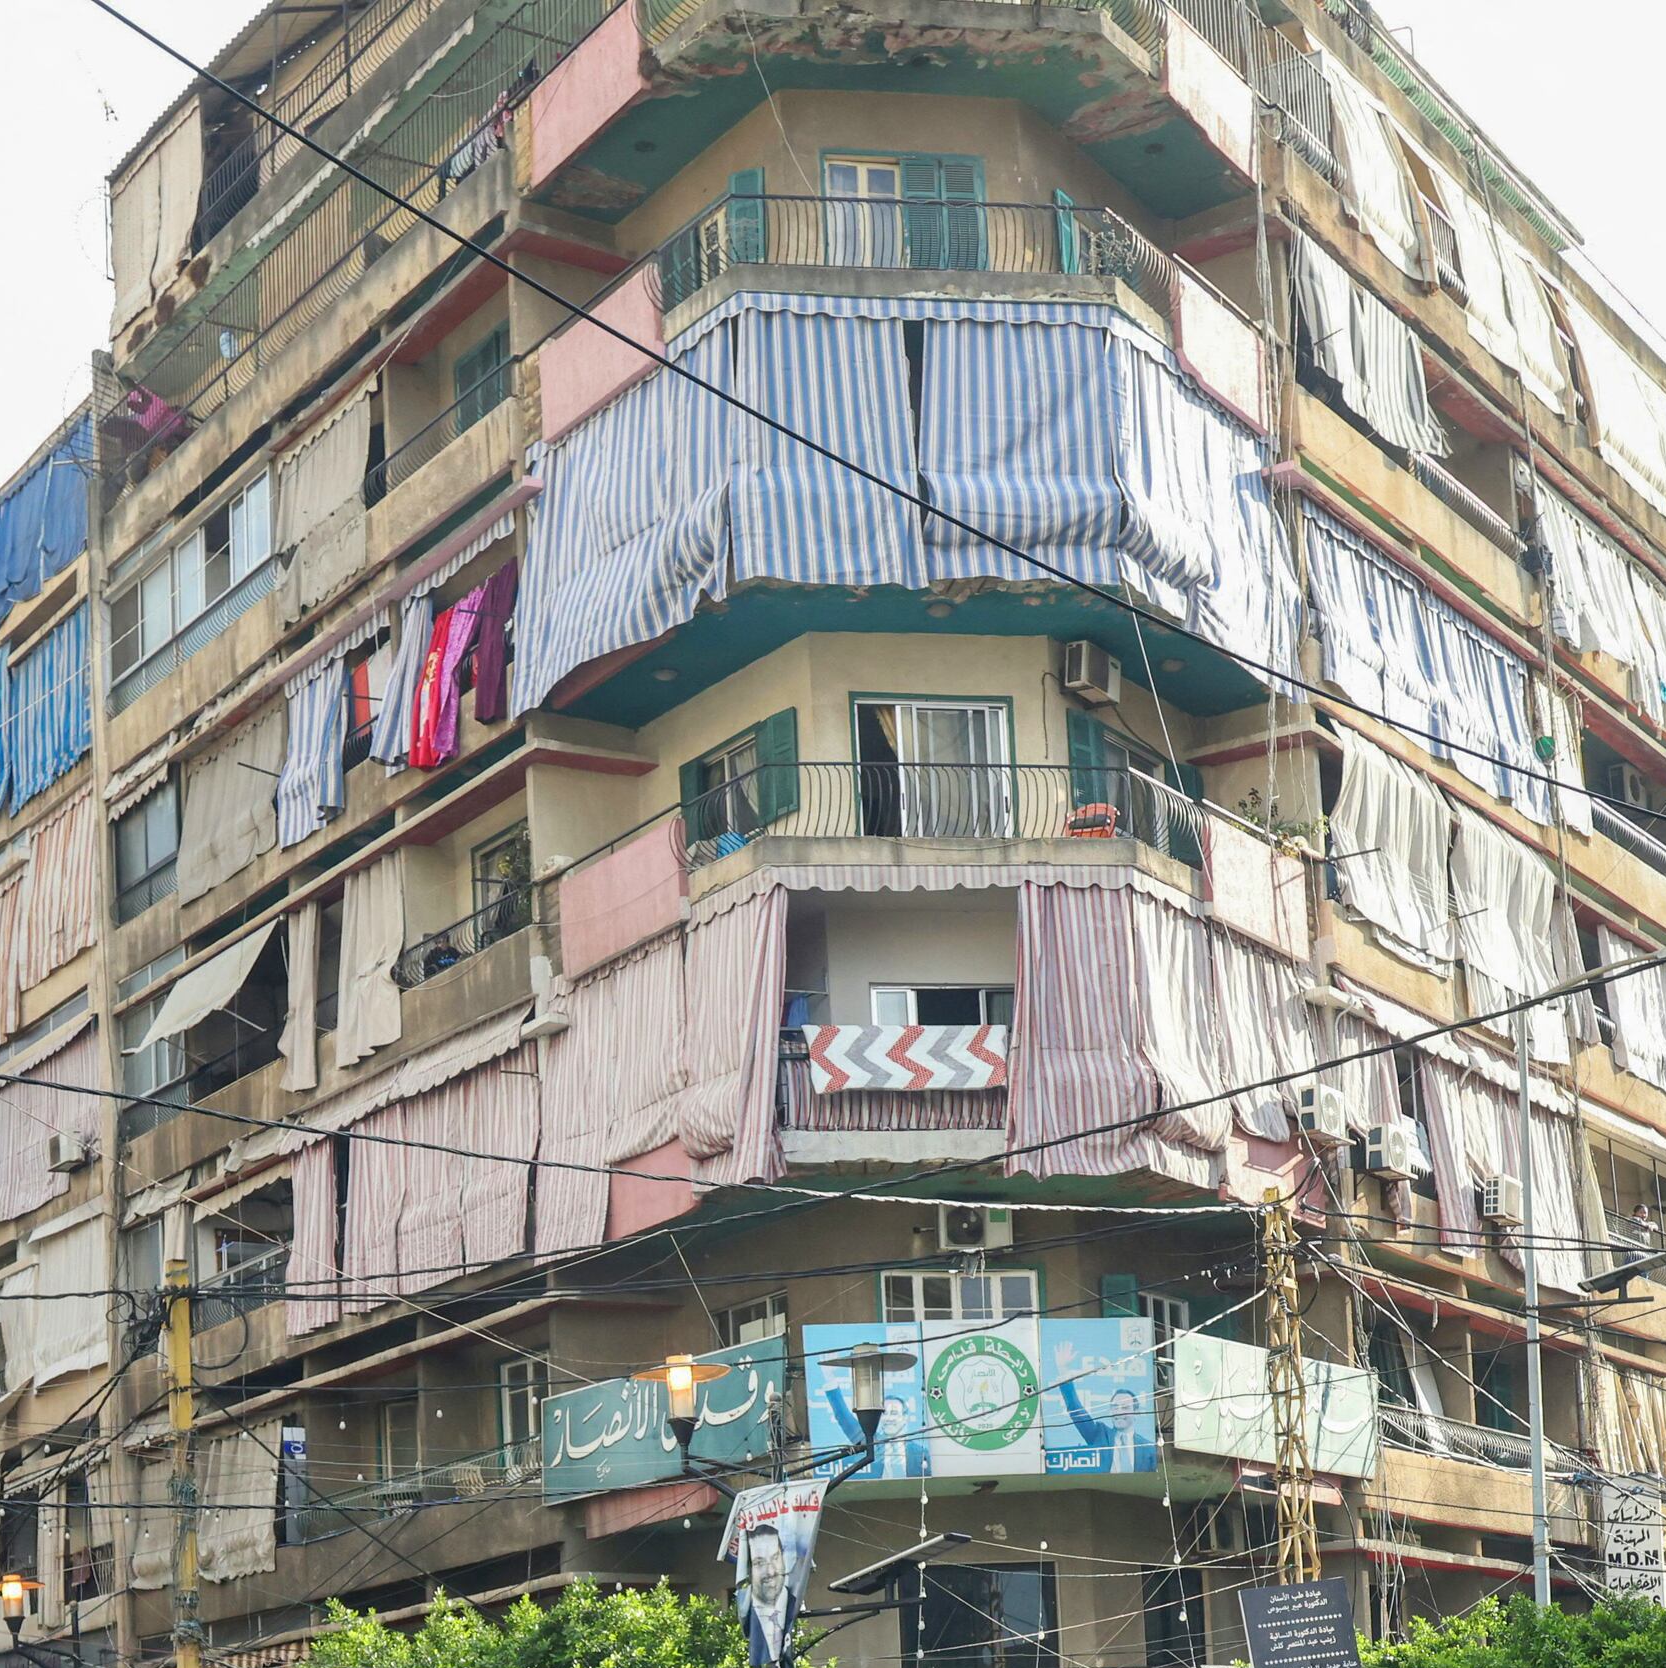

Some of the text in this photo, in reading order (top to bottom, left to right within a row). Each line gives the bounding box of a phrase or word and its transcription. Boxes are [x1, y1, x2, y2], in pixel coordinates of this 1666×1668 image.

[1608, 1550, 1659, 1568] M.D.M
[1292, 1593, 1304, 1601] طب
[1306, 1591, 1321, 1599] عيادة
[1305, 1598, 1327, 1608] الدكتورة
[1294, 1628, 1318, 1637] الدكتورة
[1319, 1626, 1335, 1634] عيادة
